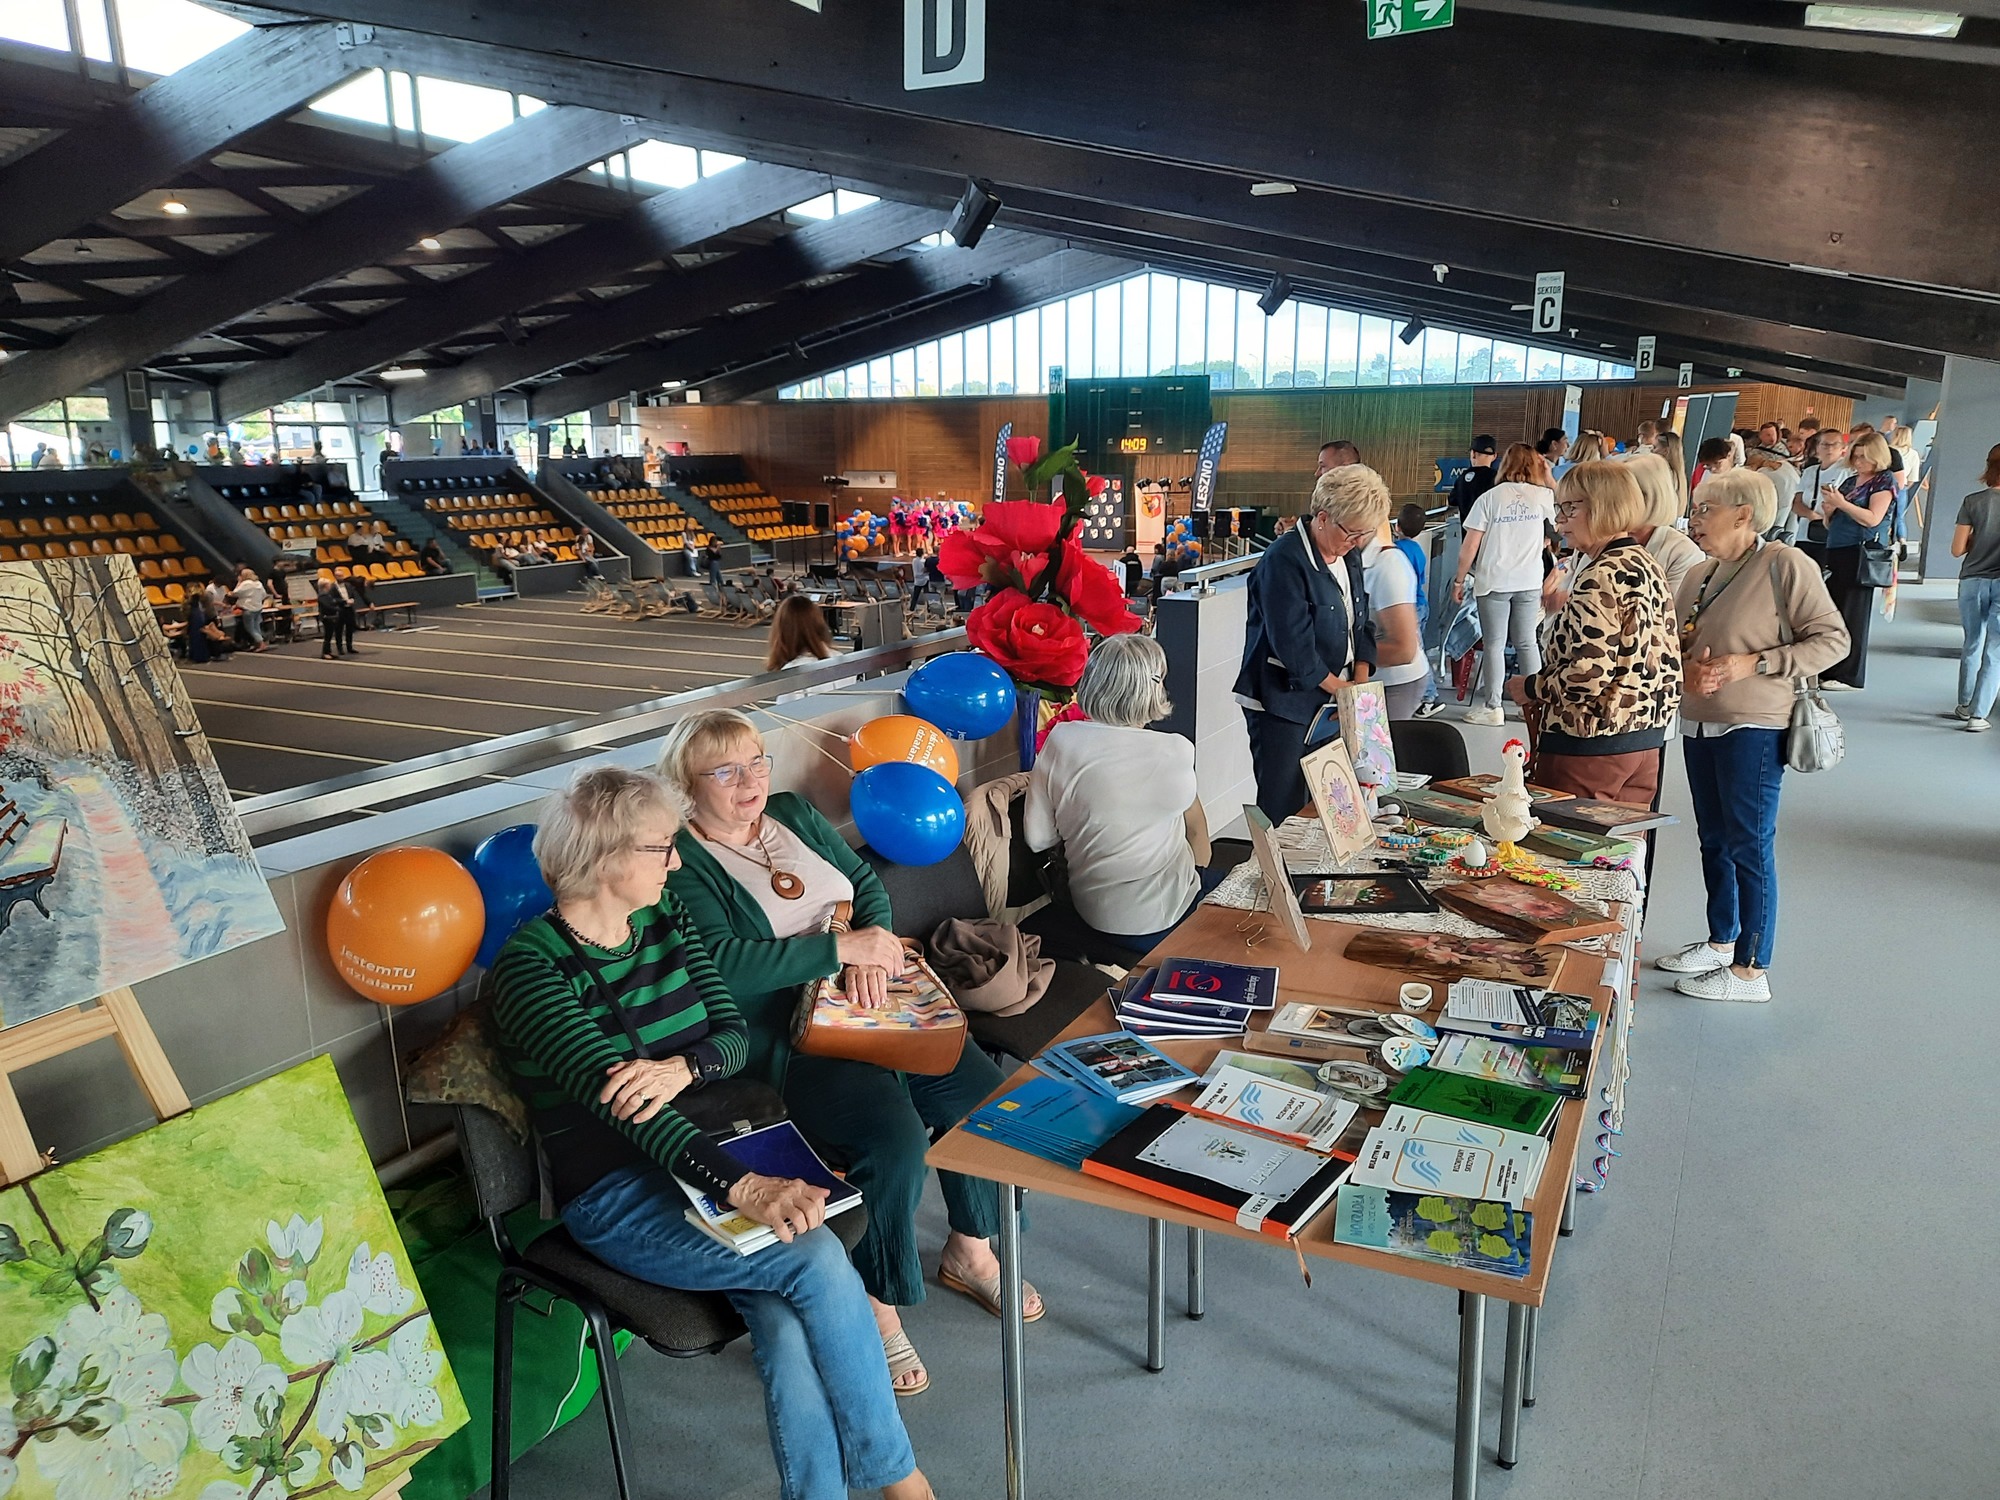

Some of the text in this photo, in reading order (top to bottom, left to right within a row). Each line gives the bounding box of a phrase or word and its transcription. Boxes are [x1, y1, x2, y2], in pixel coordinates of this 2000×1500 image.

[922, 0, 966, 74] D
[1537, 285, 1562, 296] SEKTOR
[1539, 297, 1556, 329] C
[1639, 351, 1650, 369] B
[1680, 373, 1689, 387] A
[995, 457, 1006, 503] LESZNO
[1195, 459, 1214, 509] LESZNO
